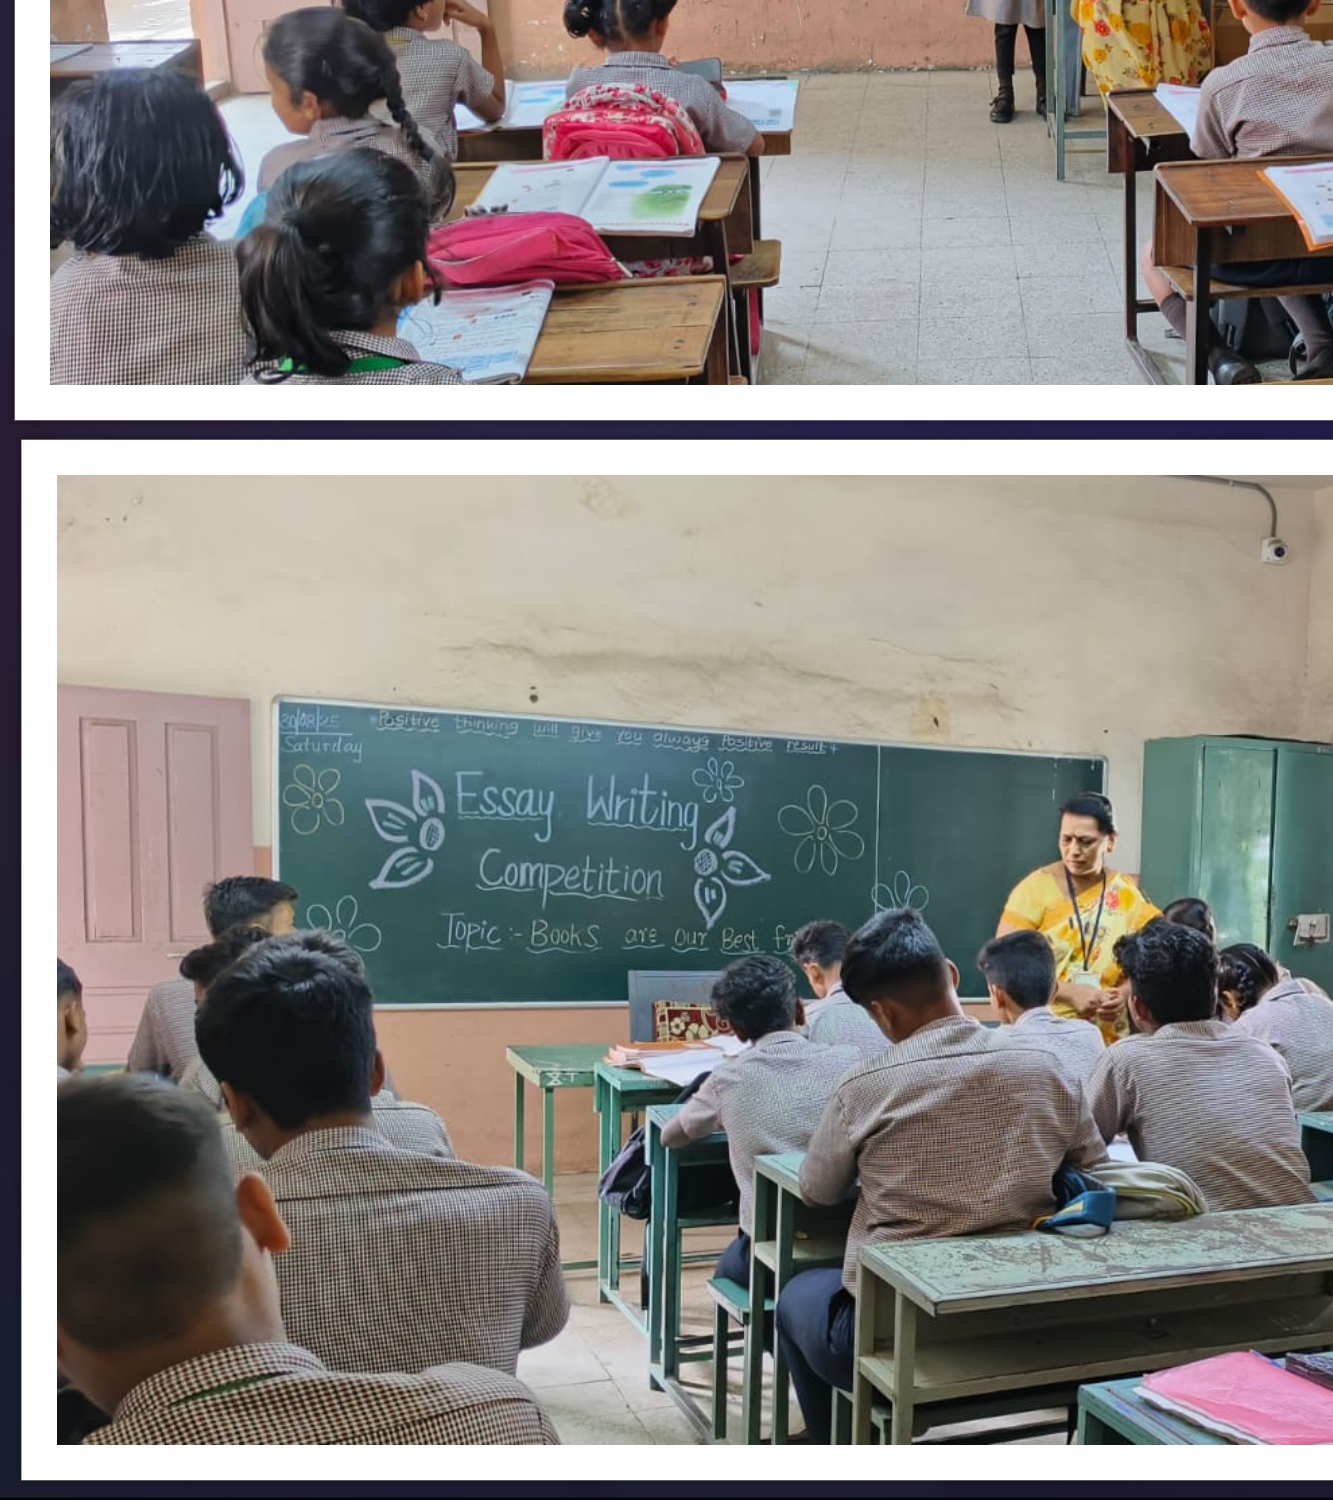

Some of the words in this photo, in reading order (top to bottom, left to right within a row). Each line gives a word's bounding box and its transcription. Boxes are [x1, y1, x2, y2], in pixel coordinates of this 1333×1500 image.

[283, 735, 364, 763] Saturday
[377, 710, 440, 729] Positive
[453, 714, 519, 736] thinking
[533, 722, 558, 735] will
[653, 732, 709, 752] always
[456, 771, 555, 842] Essay
[586, 773, 699, 850] Writing
[479, 848, 664, 911] Competition
[624, 927, 658, 945] are
[722, 927, 755, 950] Best
